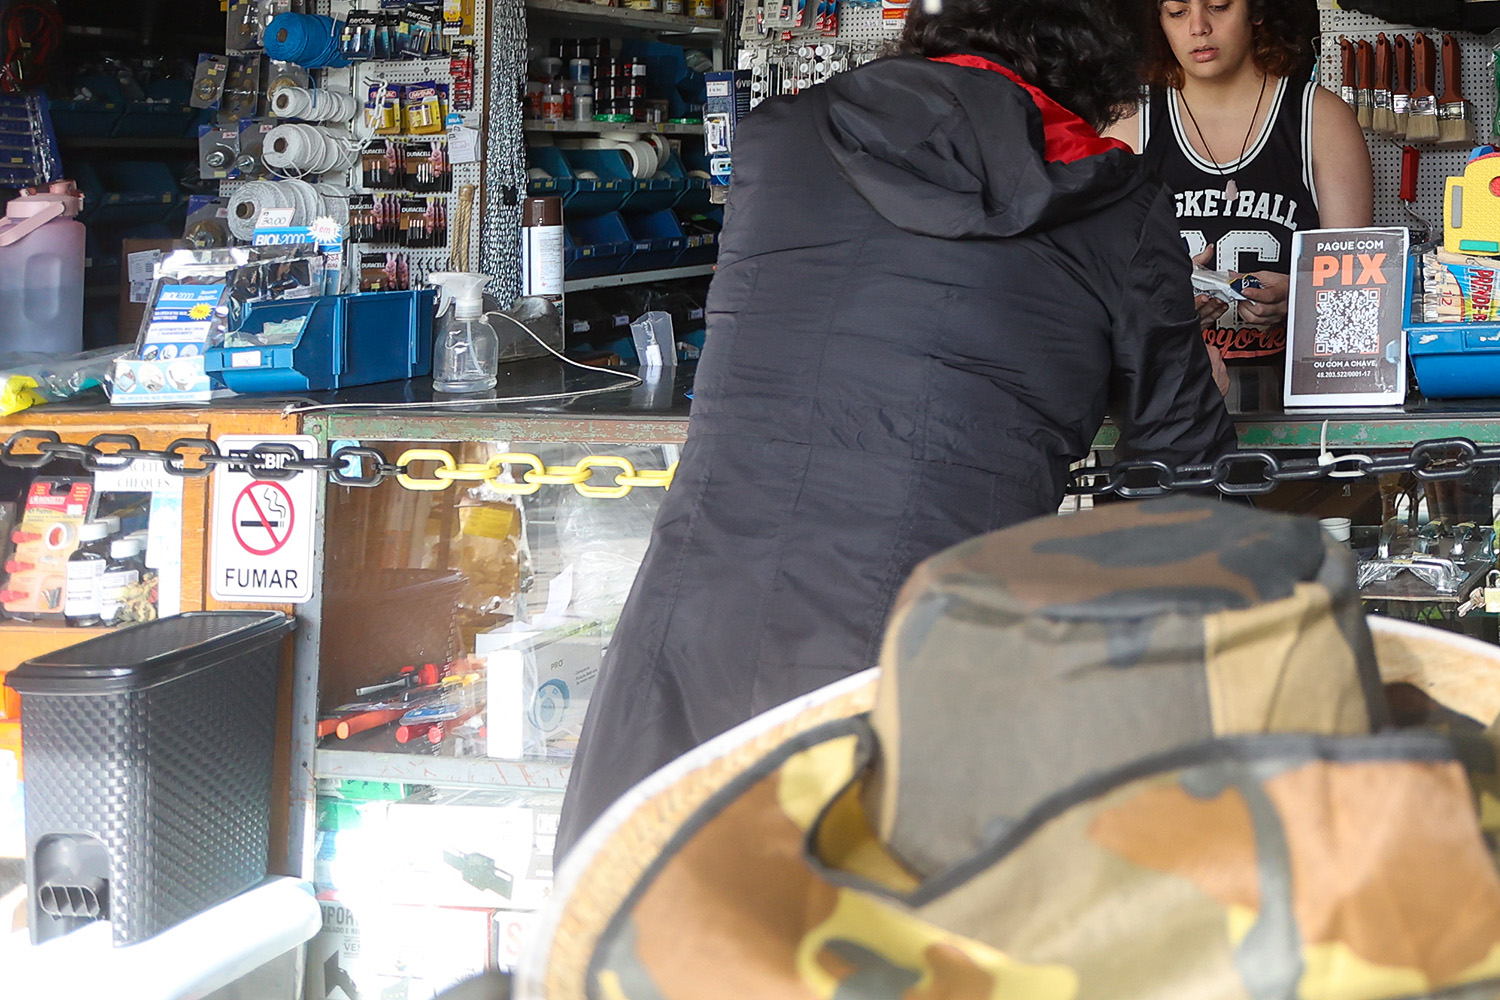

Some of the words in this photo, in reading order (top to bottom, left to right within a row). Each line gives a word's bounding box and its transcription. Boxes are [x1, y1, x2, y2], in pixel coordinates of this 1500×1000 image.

[350, 17, 375, 26] RAYOVAC
[407, 10, 432, 22] RAYOVAC
[362, 147, 386, 156] DURACELL
[402, 206, 426, 214] DURACELL
[1174, 189, 1298, 231] SKETBALL
[1317, 242, 1354, 252] PAGUE
[1357, 240, 1384, 250] COM
[1312, 253, 1388, 287] PIX
[1314, 361, 1325, 369] OU
[1326, 360, 1343, 368] COM
[225, 568, 298, 589] FUMAR
